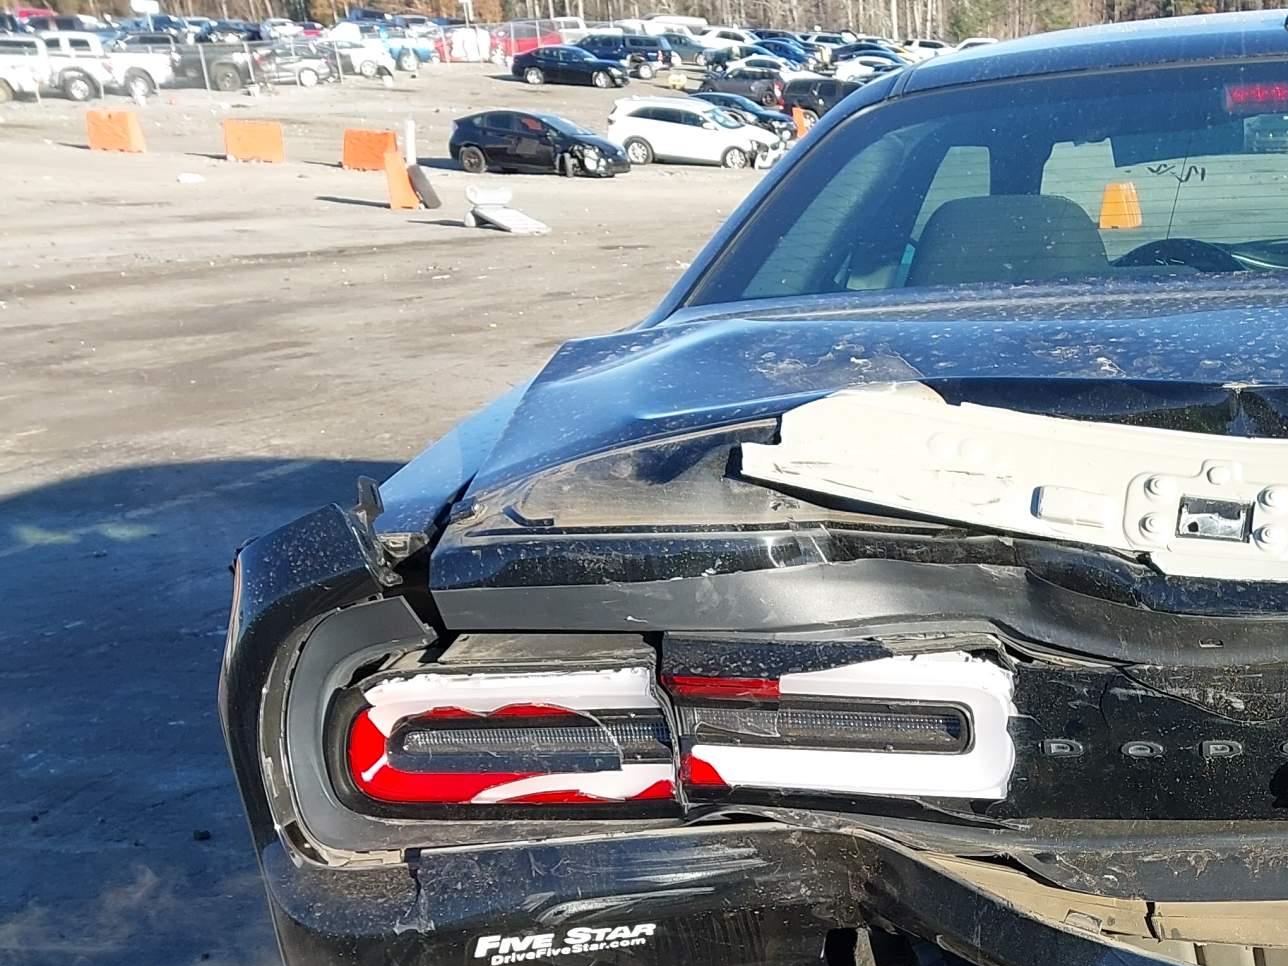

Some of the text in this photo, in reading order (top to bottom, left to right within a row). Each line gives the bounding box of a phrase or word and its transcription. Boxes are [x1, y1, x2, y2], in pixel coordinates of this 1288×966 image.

[473, 923, 656, 959] FIVE STAR
[490, 937, 647, 966] DriveFiveStar.com
